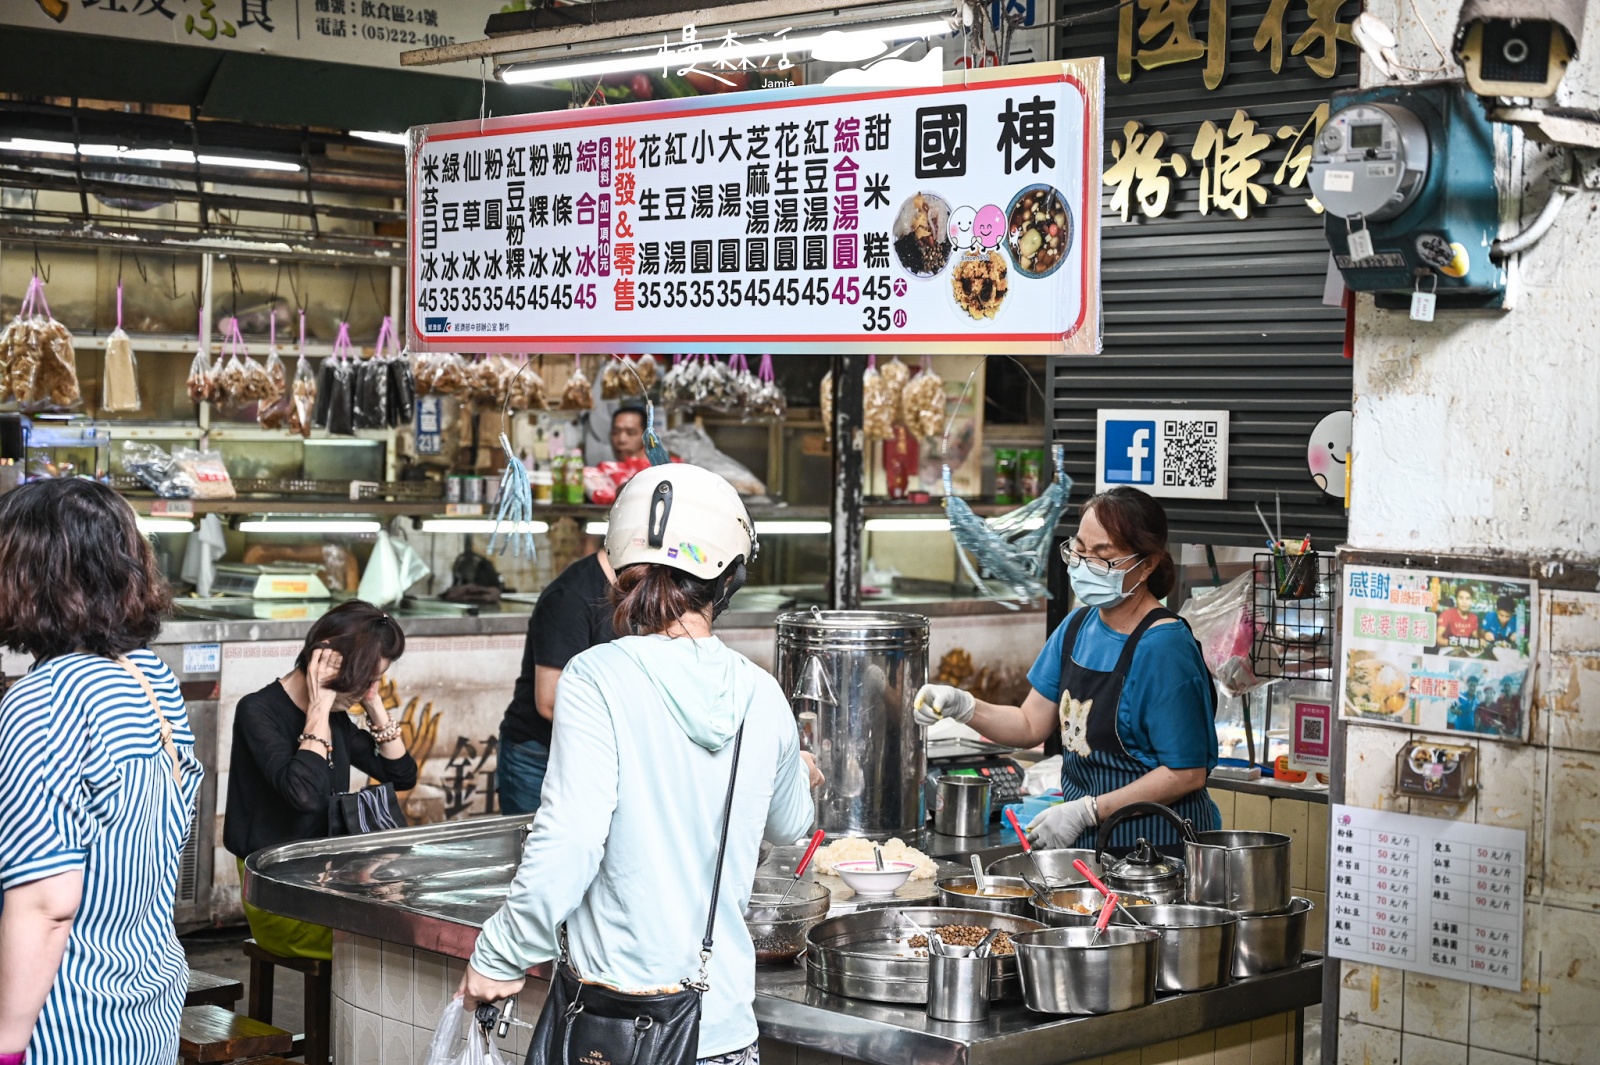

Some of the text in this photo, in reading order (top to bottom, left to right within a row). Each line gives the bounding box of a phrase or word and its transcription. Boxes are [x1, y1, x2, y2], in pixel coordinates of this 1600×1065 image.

[915, 95, 1056, 179] 國棟
[418, 287, 437, 312] 45
[440, 287, 459, 311] 35
[462, 286, 481, 311] 35
[483, 286, 502, 310] 35
[505, 285, 525, 310] 45
[528, 285, 549, 310] 45
[551, 284, 572, 310] 45
[574, 283, 596, 309] 45
[638, 282, 661, 308] 35
[663, 281, 687, 307] 35
[690, 280, 714, 307] 35
[717, 279, 742, 307] 35
[744, 279, 770, 306] 45
[773, 278, 799, 306] 45
[802, 277, 829, 305] 45
[832, 276, 860, 305] 45
[862, 276, 891, 300] 45
[862, 307, 891, 331] 35
[1349, 571, 1390, 600] 感謝
